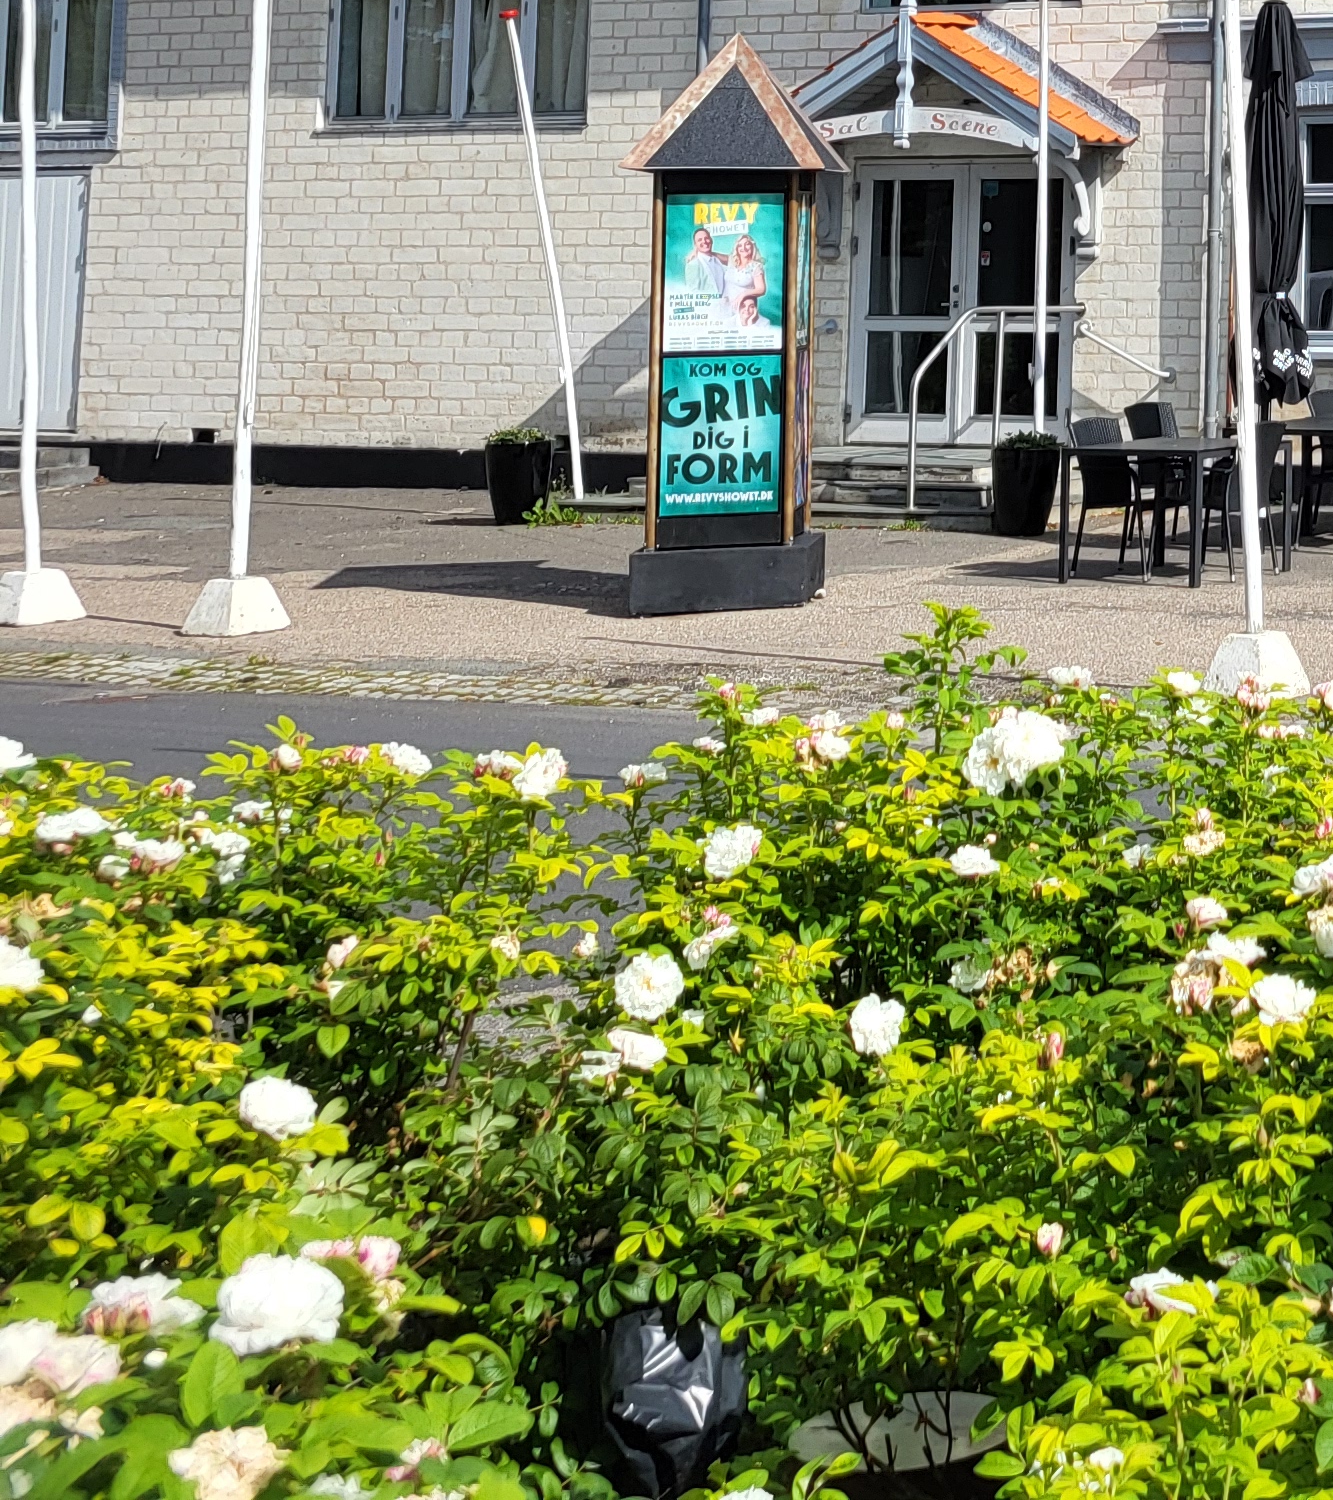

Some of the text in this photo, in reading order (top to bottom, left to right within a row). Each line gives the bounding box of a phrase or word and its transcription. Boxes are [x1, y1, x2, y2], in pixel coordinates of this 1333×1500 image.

[819, 112, 998, 138] Sal Scene
[694, 202, 759, 225] REVY
[689, 362, 763, 378] KOM OG
[662, 374, 781, 428] GRIN
[666, 451, 772, 486] FORM
[665, 490, 774, 505] WWW.REVYSHOWET.DK
